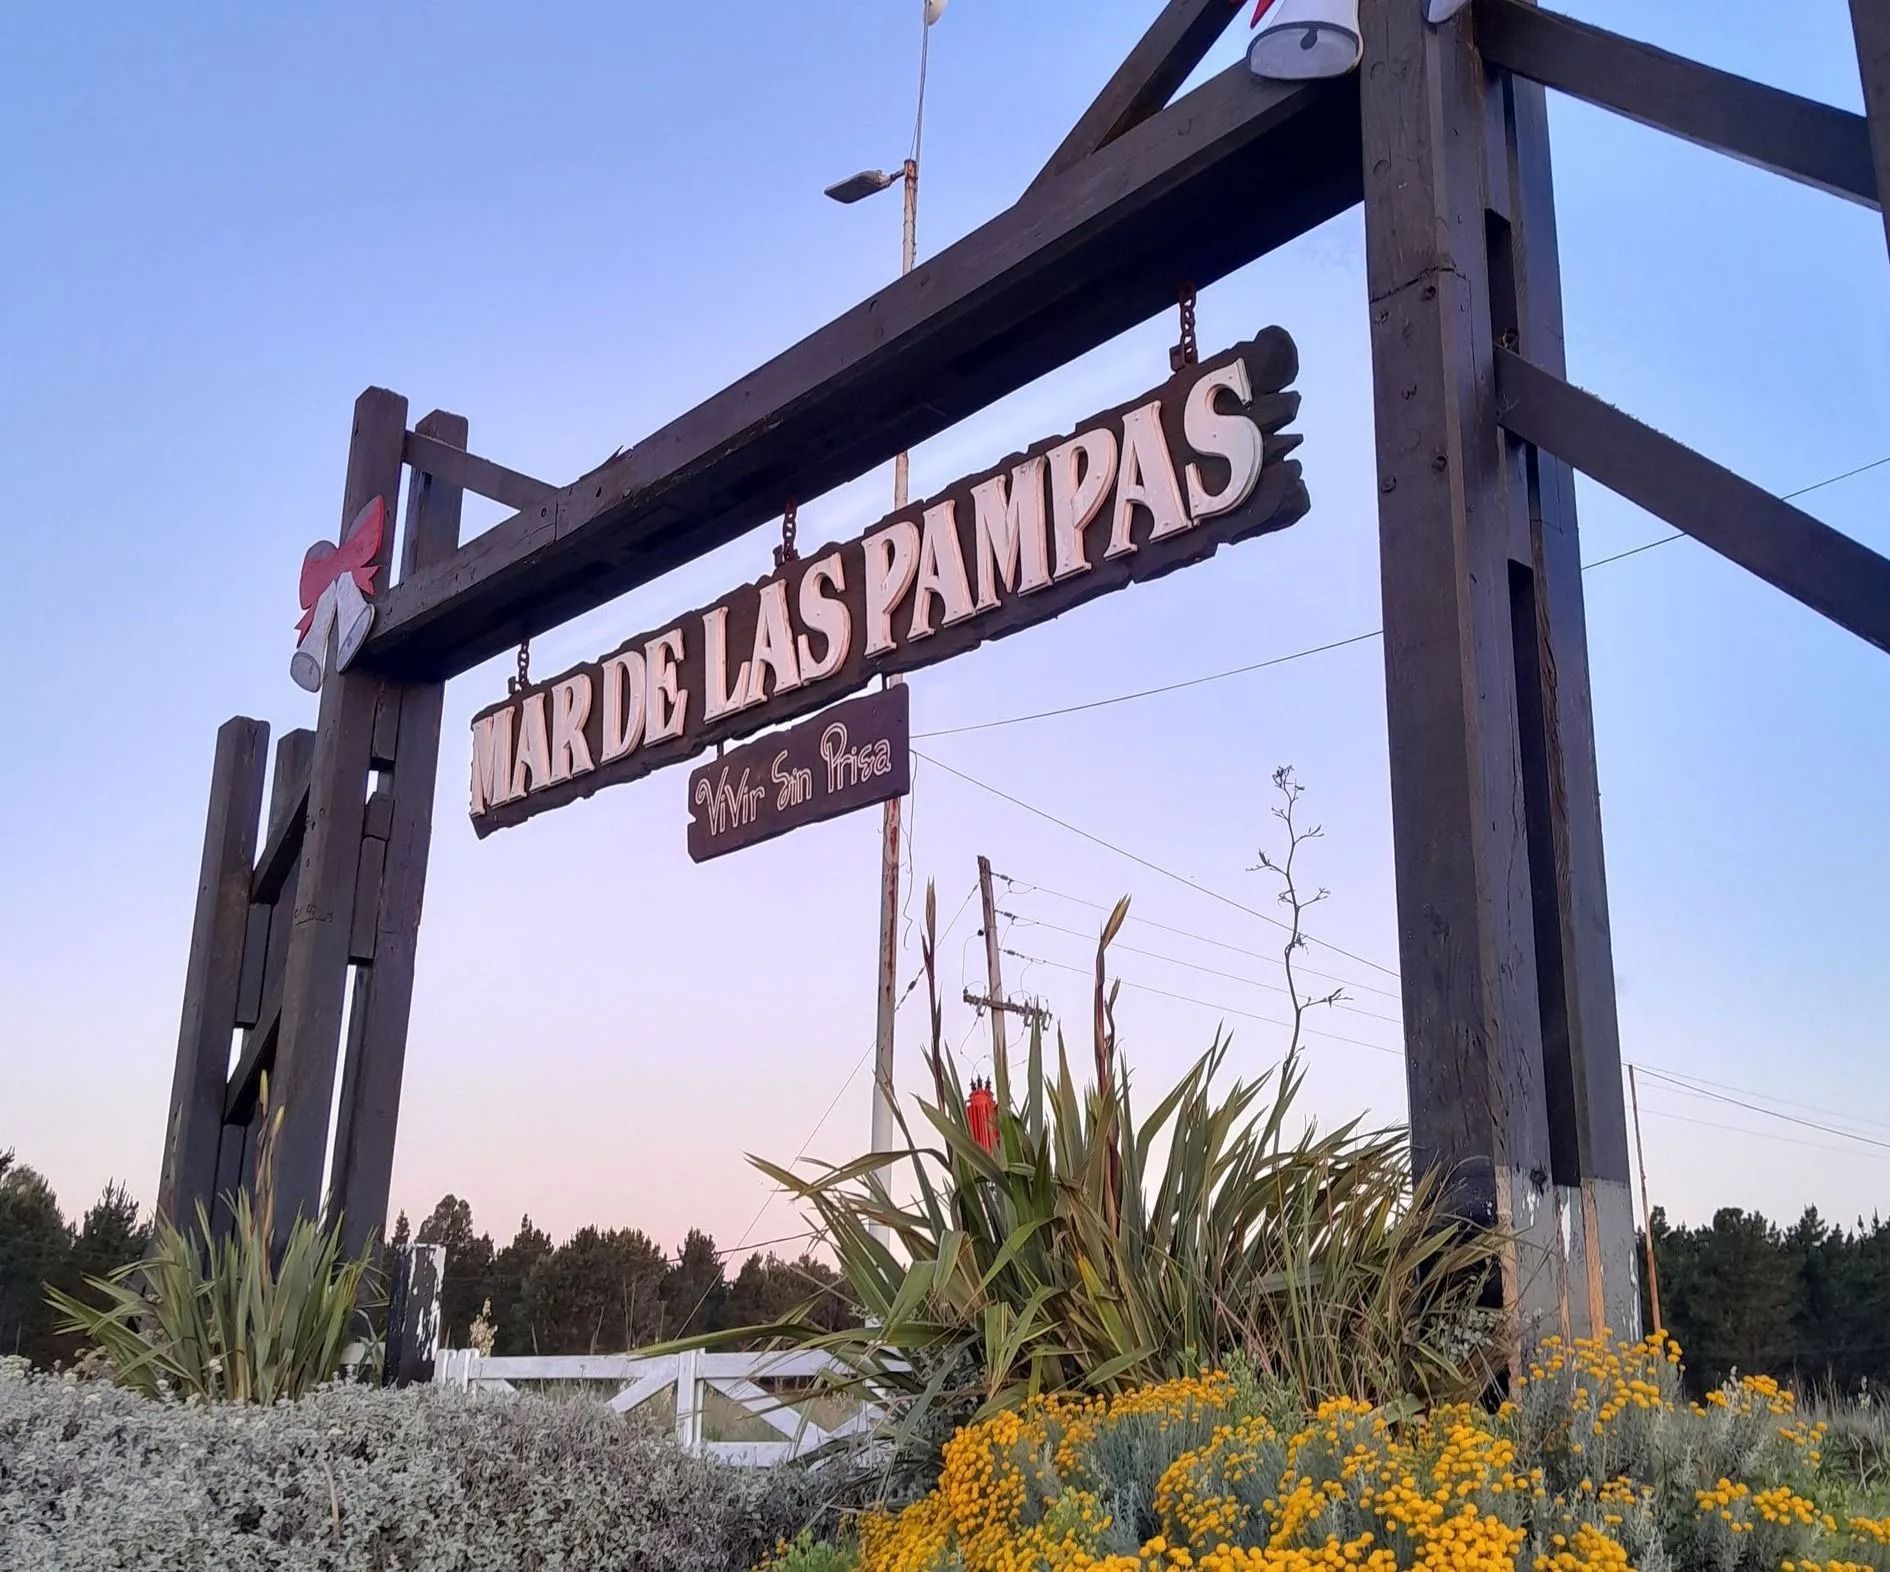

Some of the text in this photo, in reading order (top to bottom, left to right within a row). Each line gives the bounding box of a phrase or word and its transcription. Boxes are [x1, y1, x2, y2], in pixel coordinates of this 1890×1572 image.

[469, 357, 1264, 816] MAR DE LAS PAMPAS
[771, 750, 813, 812] Sin
[820, 721, 892, 794] Prisa
